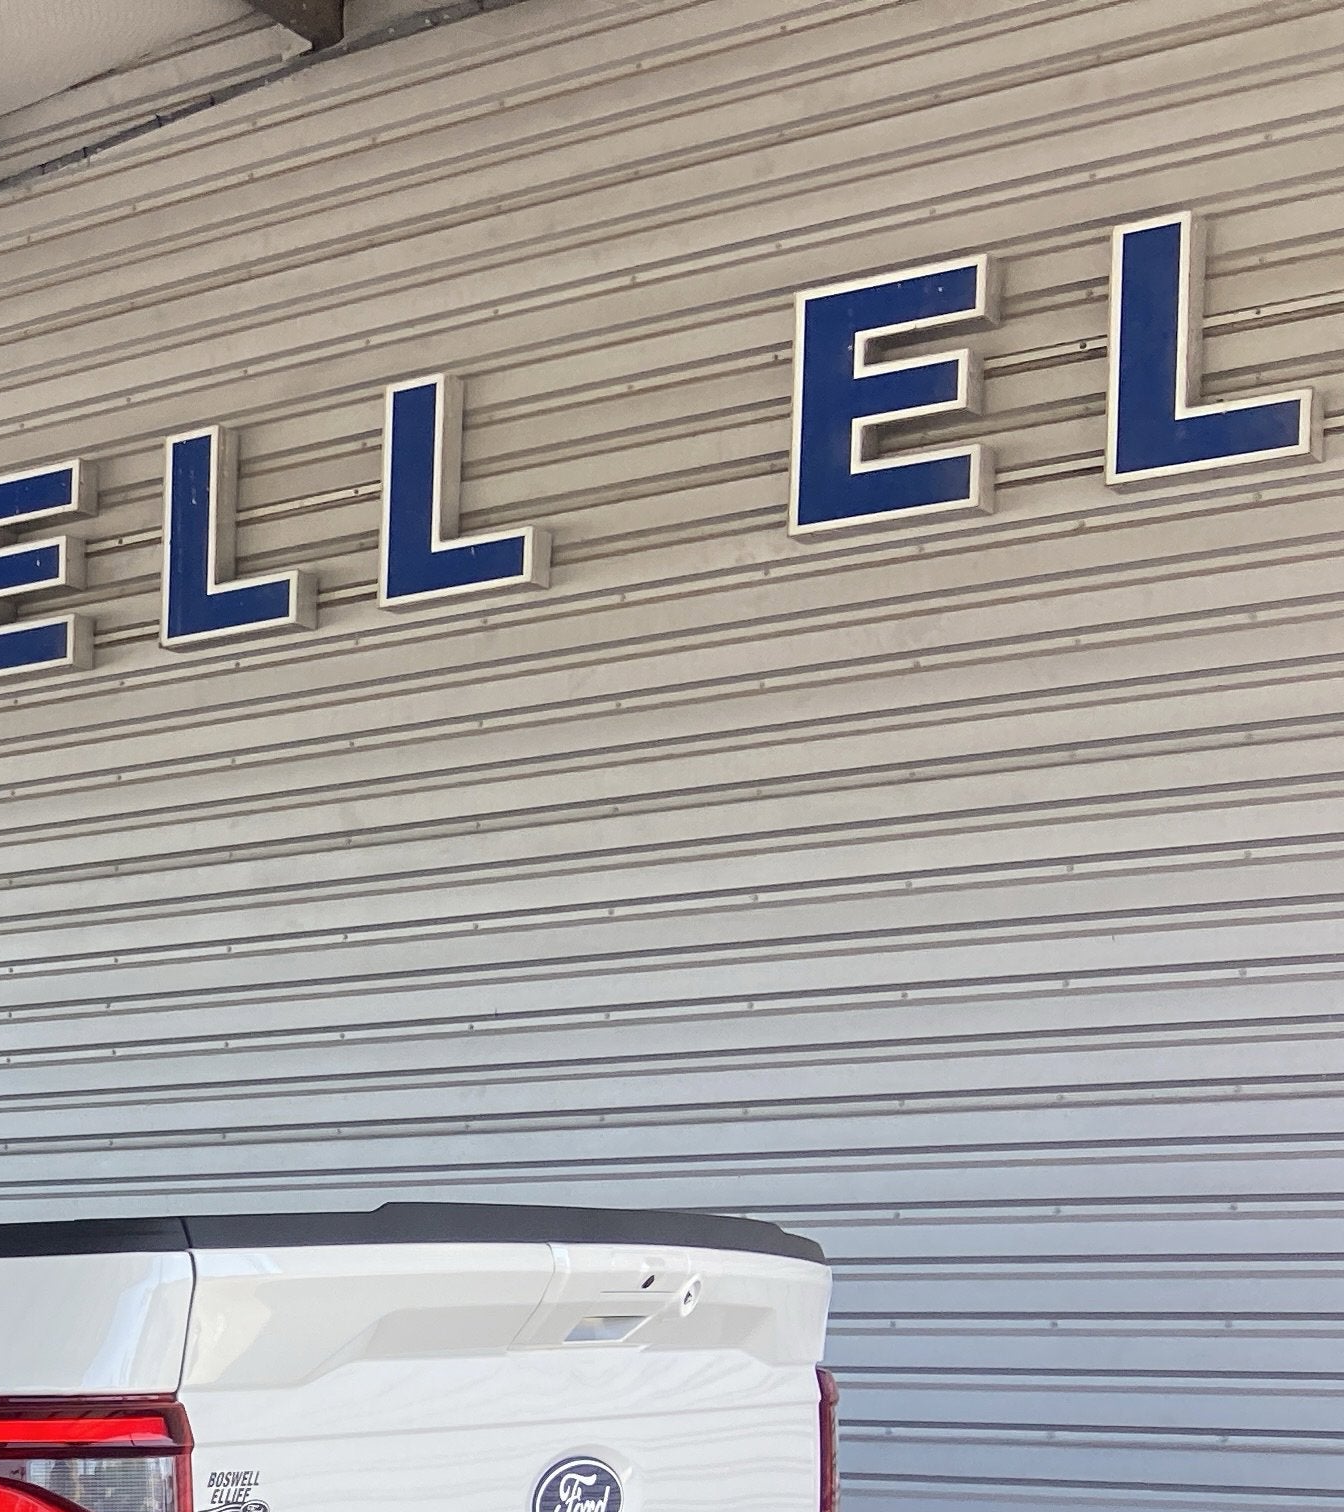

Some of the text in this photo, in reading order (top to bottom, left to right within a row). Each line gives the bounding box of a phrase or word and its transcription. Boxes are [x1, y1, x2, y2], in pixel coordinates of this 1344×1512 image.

[788, 210, 1322, 536] EL
[207, 1471, 260, 1487] BOSWELL
[210, 1488, 252, 1504] ELLIFF
